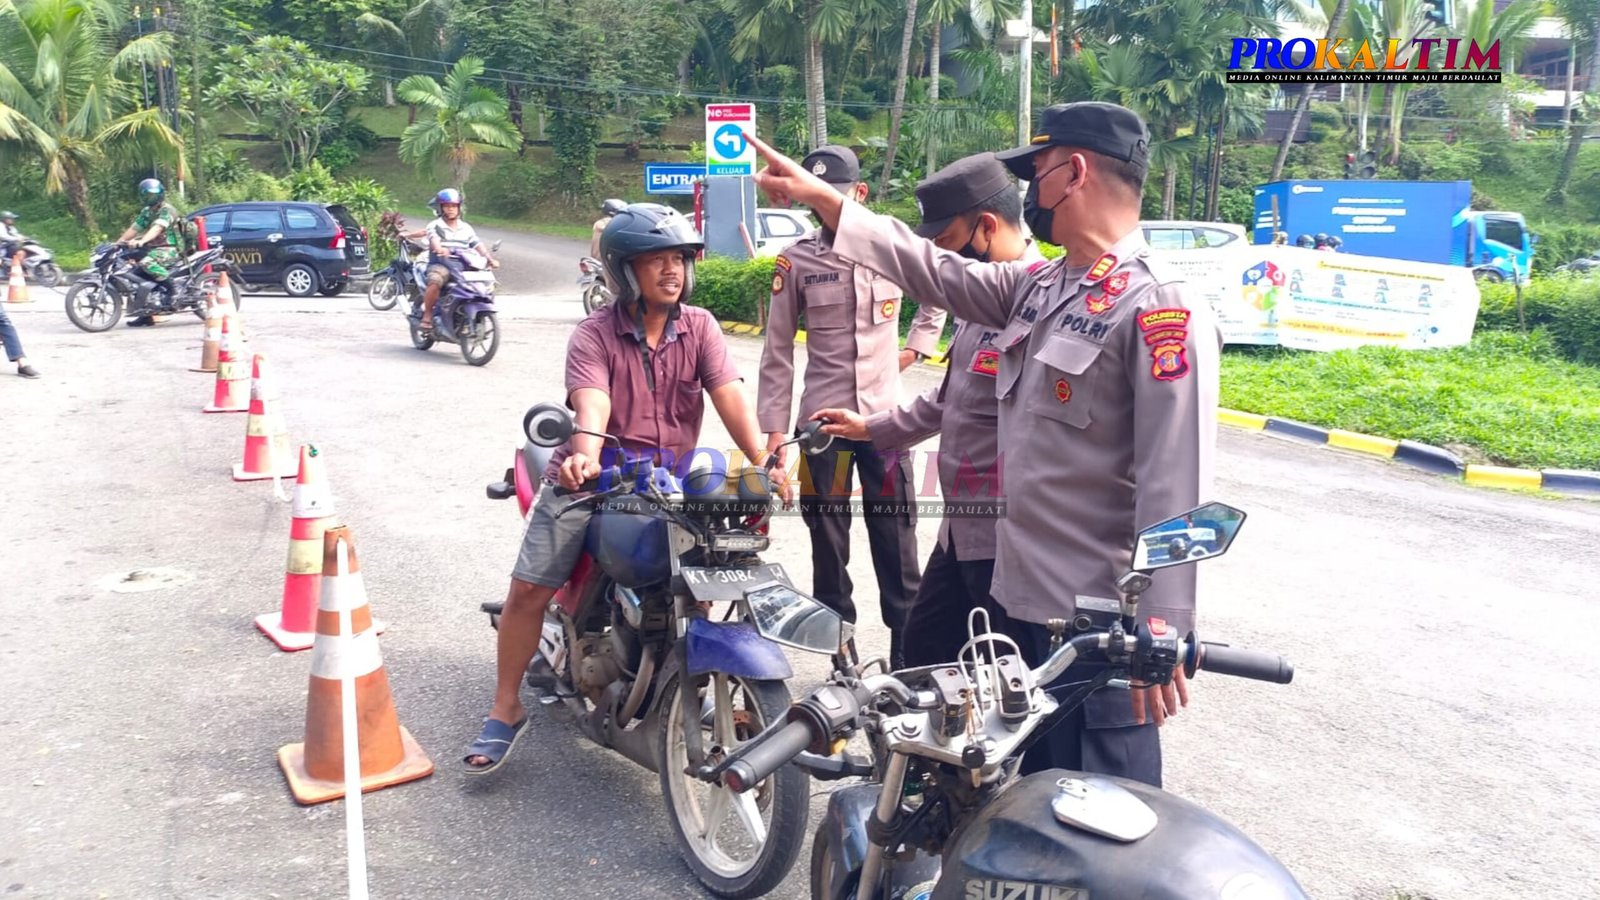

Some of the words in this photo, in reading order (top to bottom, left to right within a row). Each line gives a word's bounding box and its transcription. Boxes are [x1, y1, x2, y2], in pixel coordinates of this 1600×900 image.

[223, 251, 263, 264] own
[804, 272, 839, 285] SETIAWAN
[1061, 313, 1109, 339] POLRI
[686, 570, 710, 585] KT
